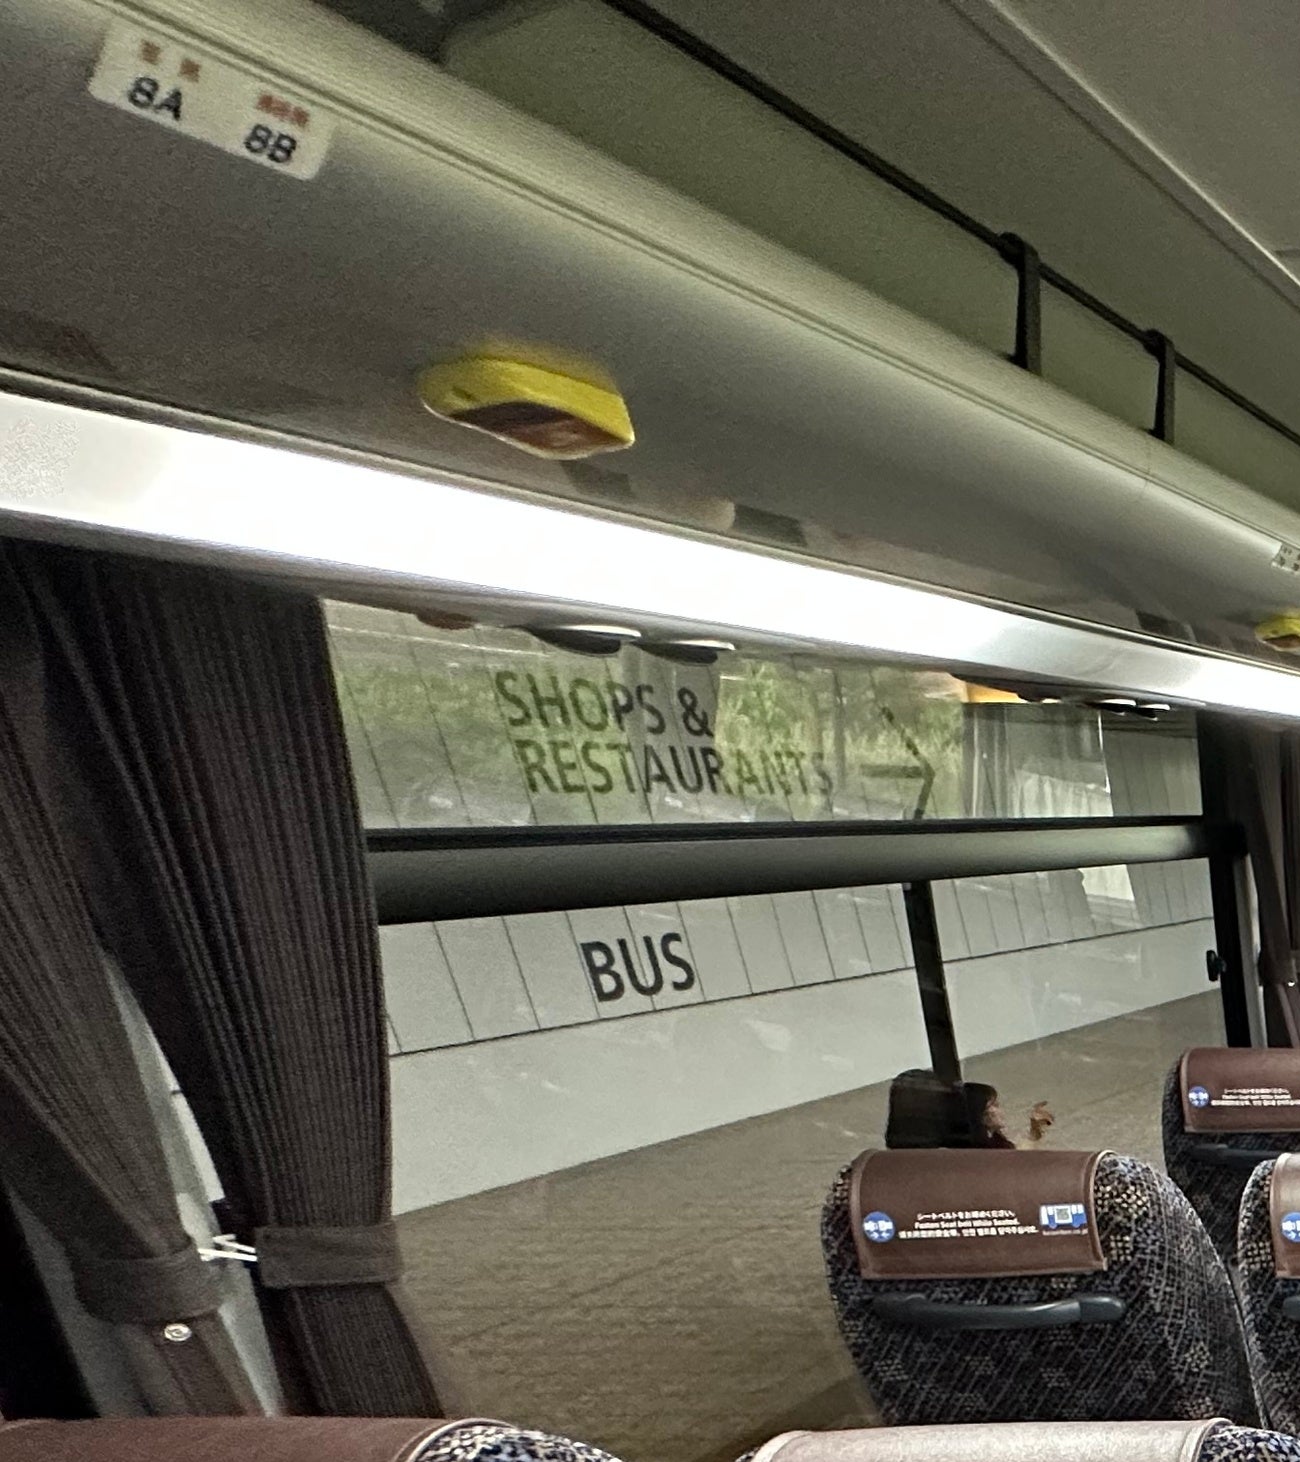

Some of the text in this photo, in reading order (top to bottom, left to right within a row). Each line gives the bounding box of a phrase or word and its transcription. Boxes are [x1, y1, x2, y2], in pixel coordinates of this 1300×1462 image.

[128, 76, 297, 163] 8A 8B
[495, 670, 715, 739] SHOPS &
[515, 738, 834, 796] RESTAURANTS
[580, 932, 695, 1002] BUS
